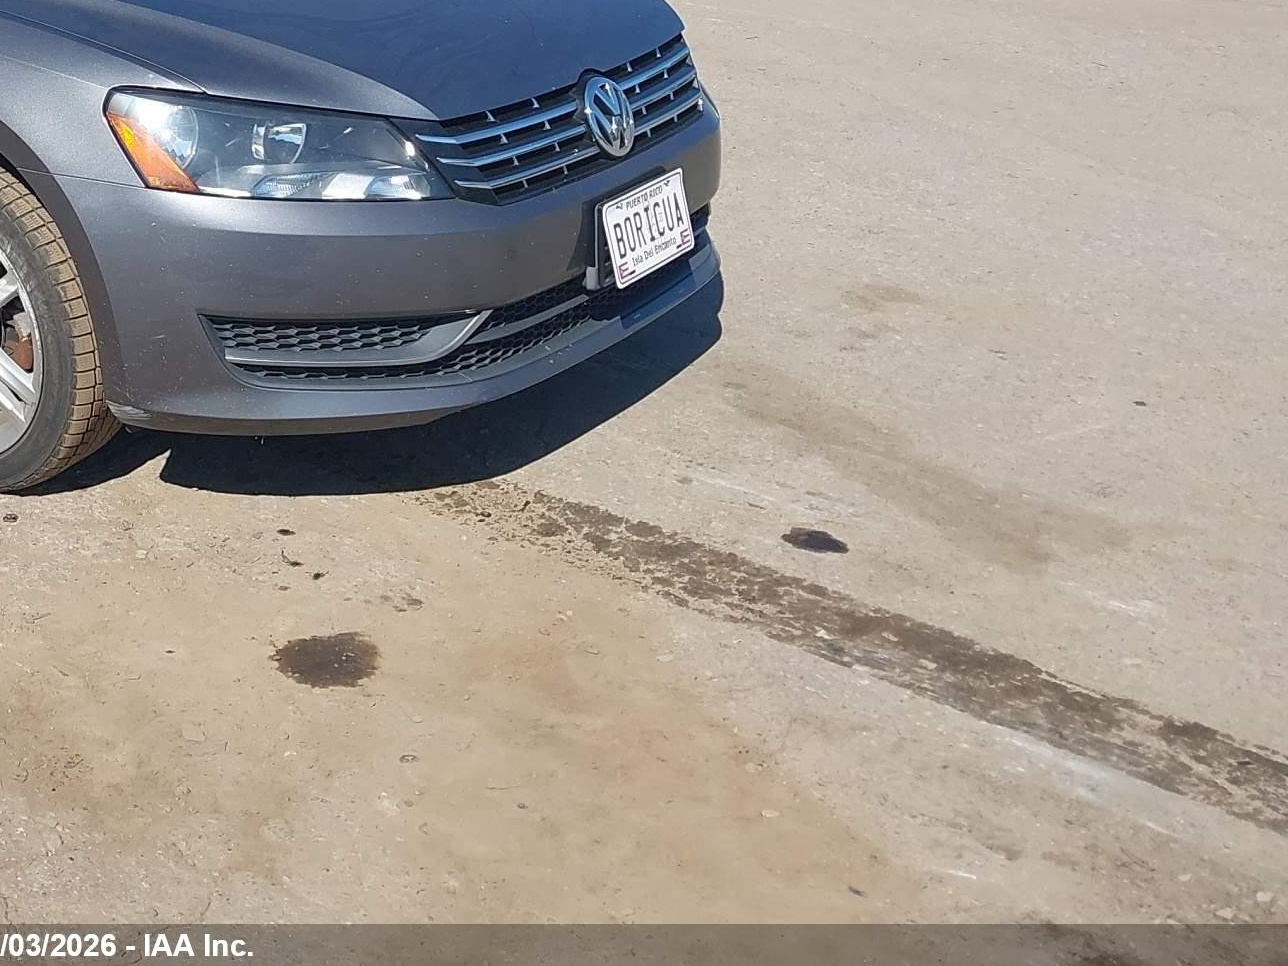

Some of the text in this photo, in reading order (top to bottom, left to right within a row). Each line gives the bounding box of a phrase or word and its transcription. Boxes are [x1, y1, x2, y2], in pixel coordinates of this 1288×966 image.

[626, 186, 663, 211] PUERTO RICO
[613, 191, 685, 260] BORICUA
[632, 237, 677, 267] Isla Del Encanto
